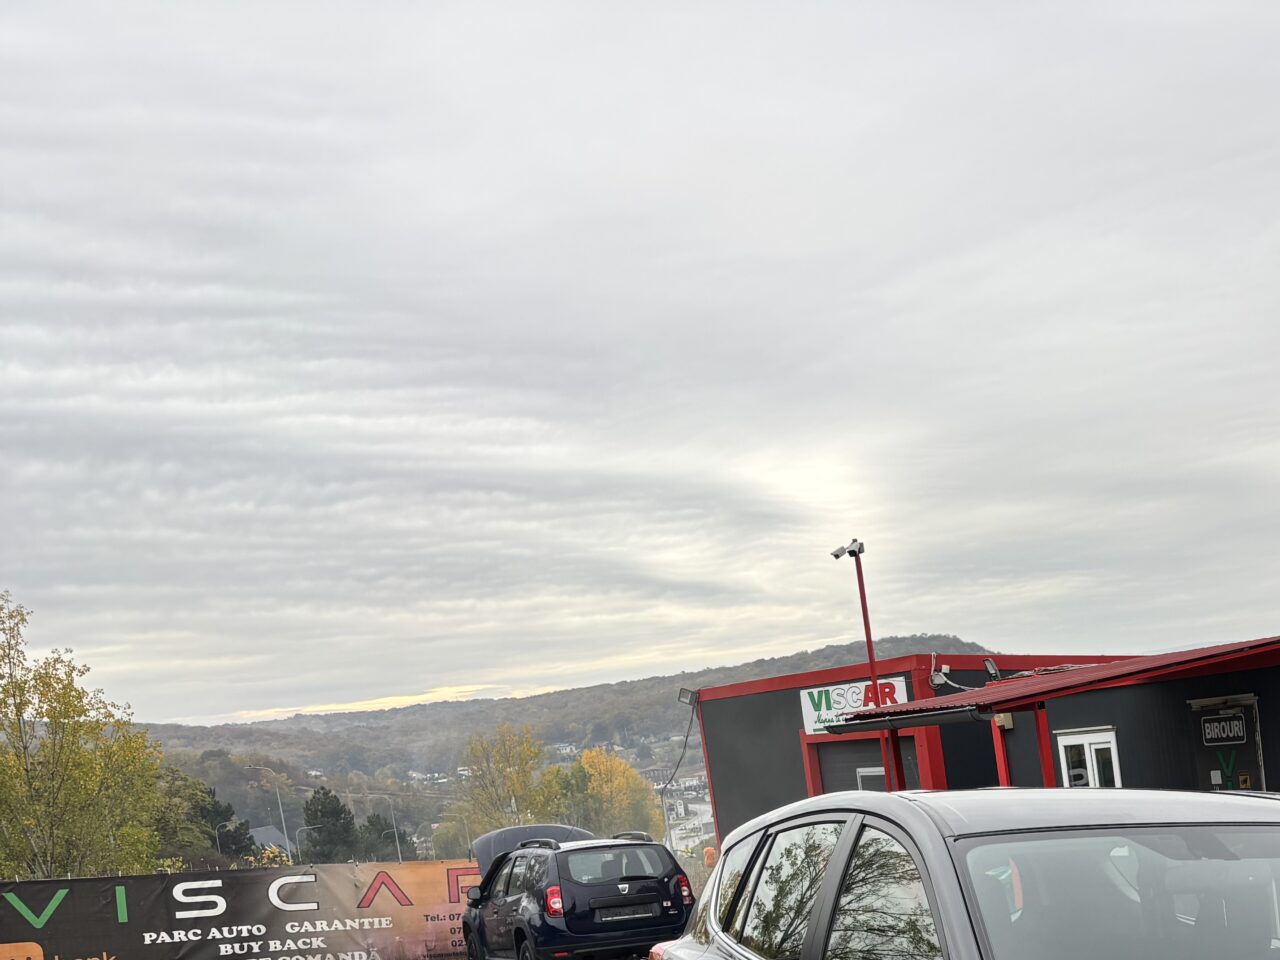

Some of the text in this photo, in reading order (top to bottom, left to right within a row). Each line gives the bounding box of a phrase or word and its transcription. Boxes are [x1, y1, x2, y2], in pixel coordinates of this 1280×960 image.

[808, 682, 898, 712] VISCAR
[1204, 721, 1244, 739] BIROURI
[143, 917, 392, 945] PARC AUTO GARANTIE
[219, 937, 327, 955] BUY BACK
